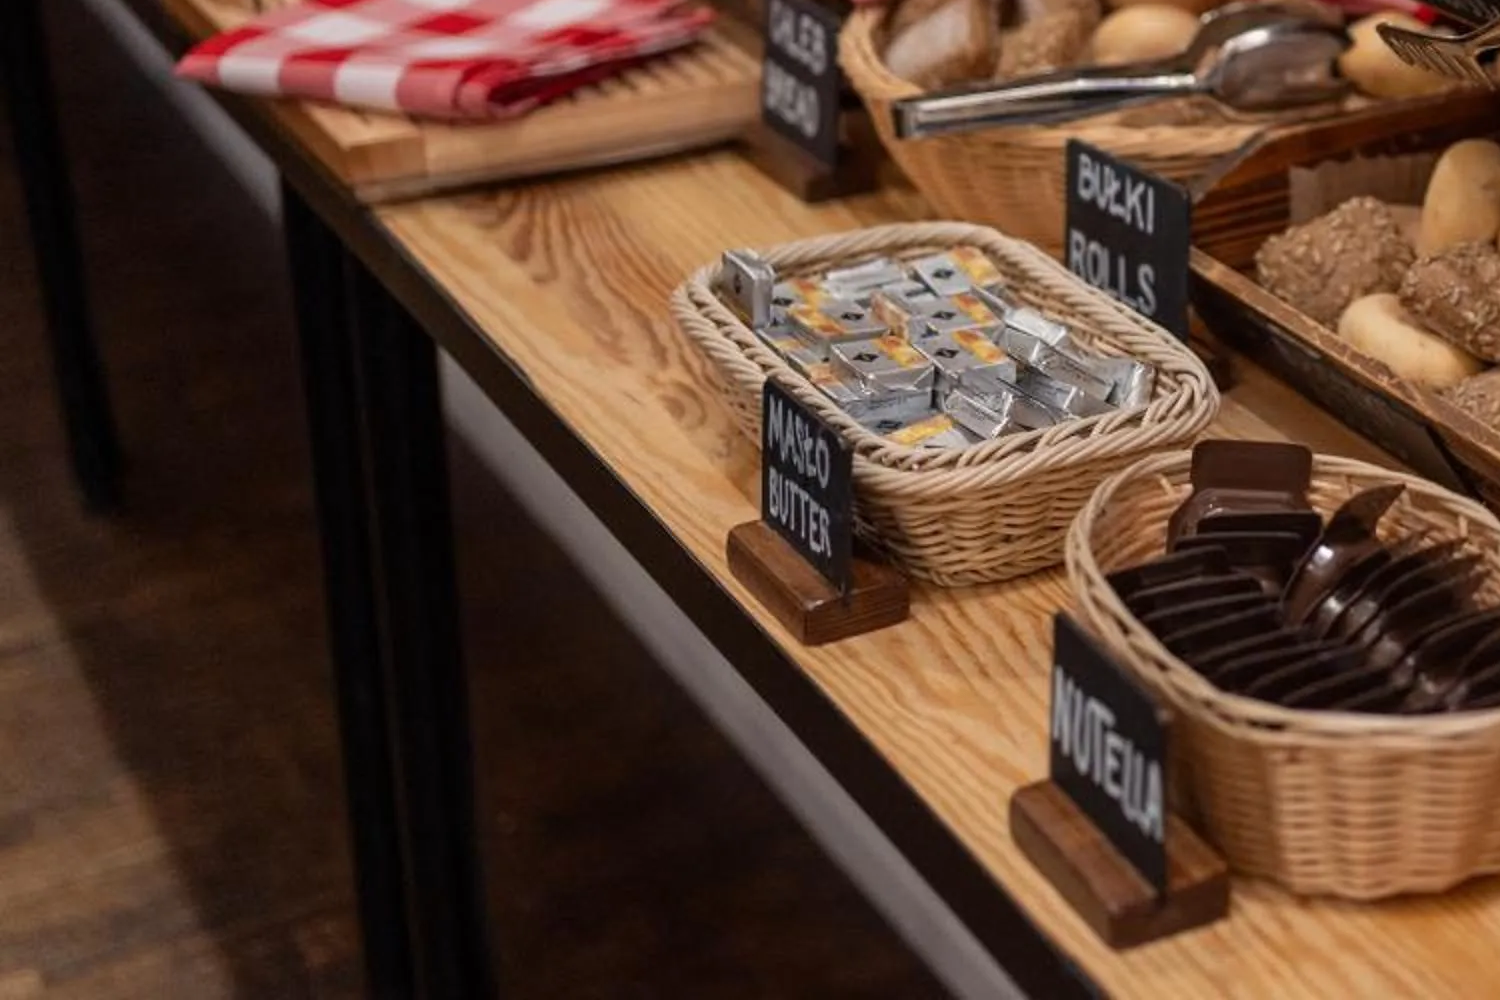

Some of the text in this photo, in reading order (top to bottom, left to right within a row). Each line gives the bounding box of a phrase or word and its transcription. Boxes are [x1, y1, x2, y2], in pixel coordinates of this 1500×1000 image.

[1077, 152, 1155, 235] BUŁKI
[1069, 228, 1157, 317] ROLLS
[767, 394, 831, 489] MASŁO
[767, 466, 832, 558] BUTTER
[1052, 665, 1165, 842] NUTELLA
